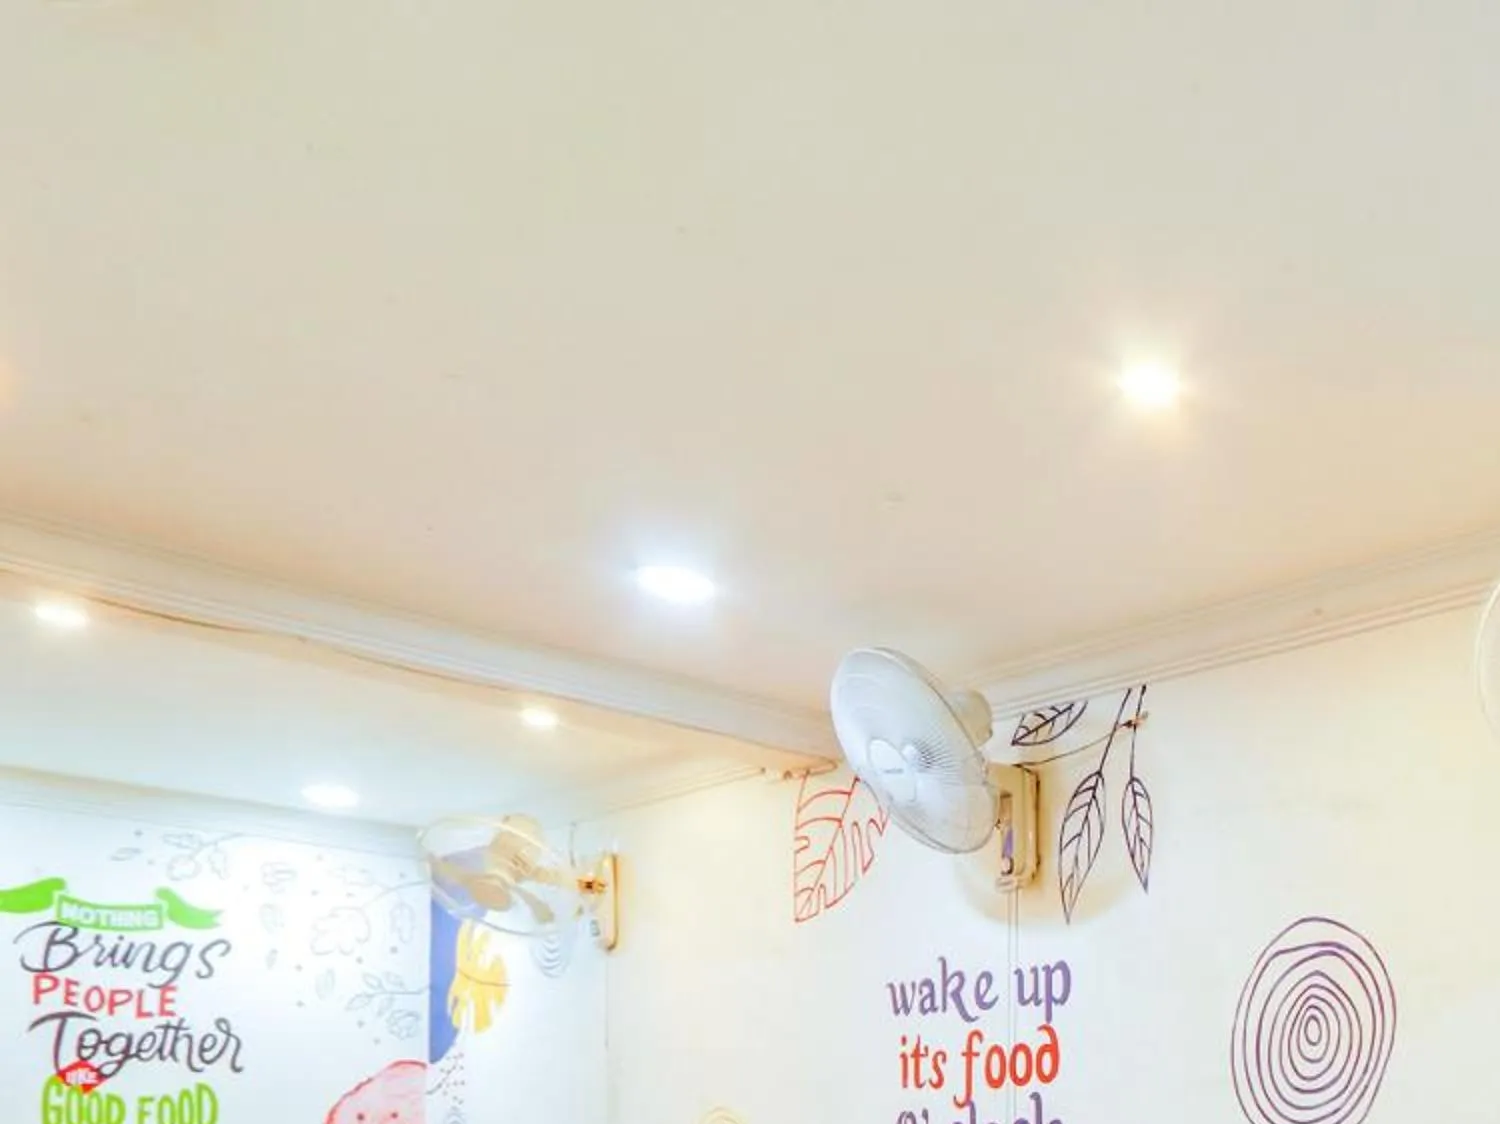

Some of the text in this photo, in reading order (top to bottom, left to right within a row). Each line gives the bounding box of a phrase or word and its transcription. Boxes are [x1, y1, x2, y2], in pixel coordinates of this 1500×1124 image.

[61, 903, 158, 928] NOTHING
[13, 920, 232, 989] Brings
[31, 971, 179, 1018] PEOPLE
[886, 956, 1072, 1024] wake up
[28, 1011, 244, 1079] Together
[953, 1023, 1061, 1109] food
